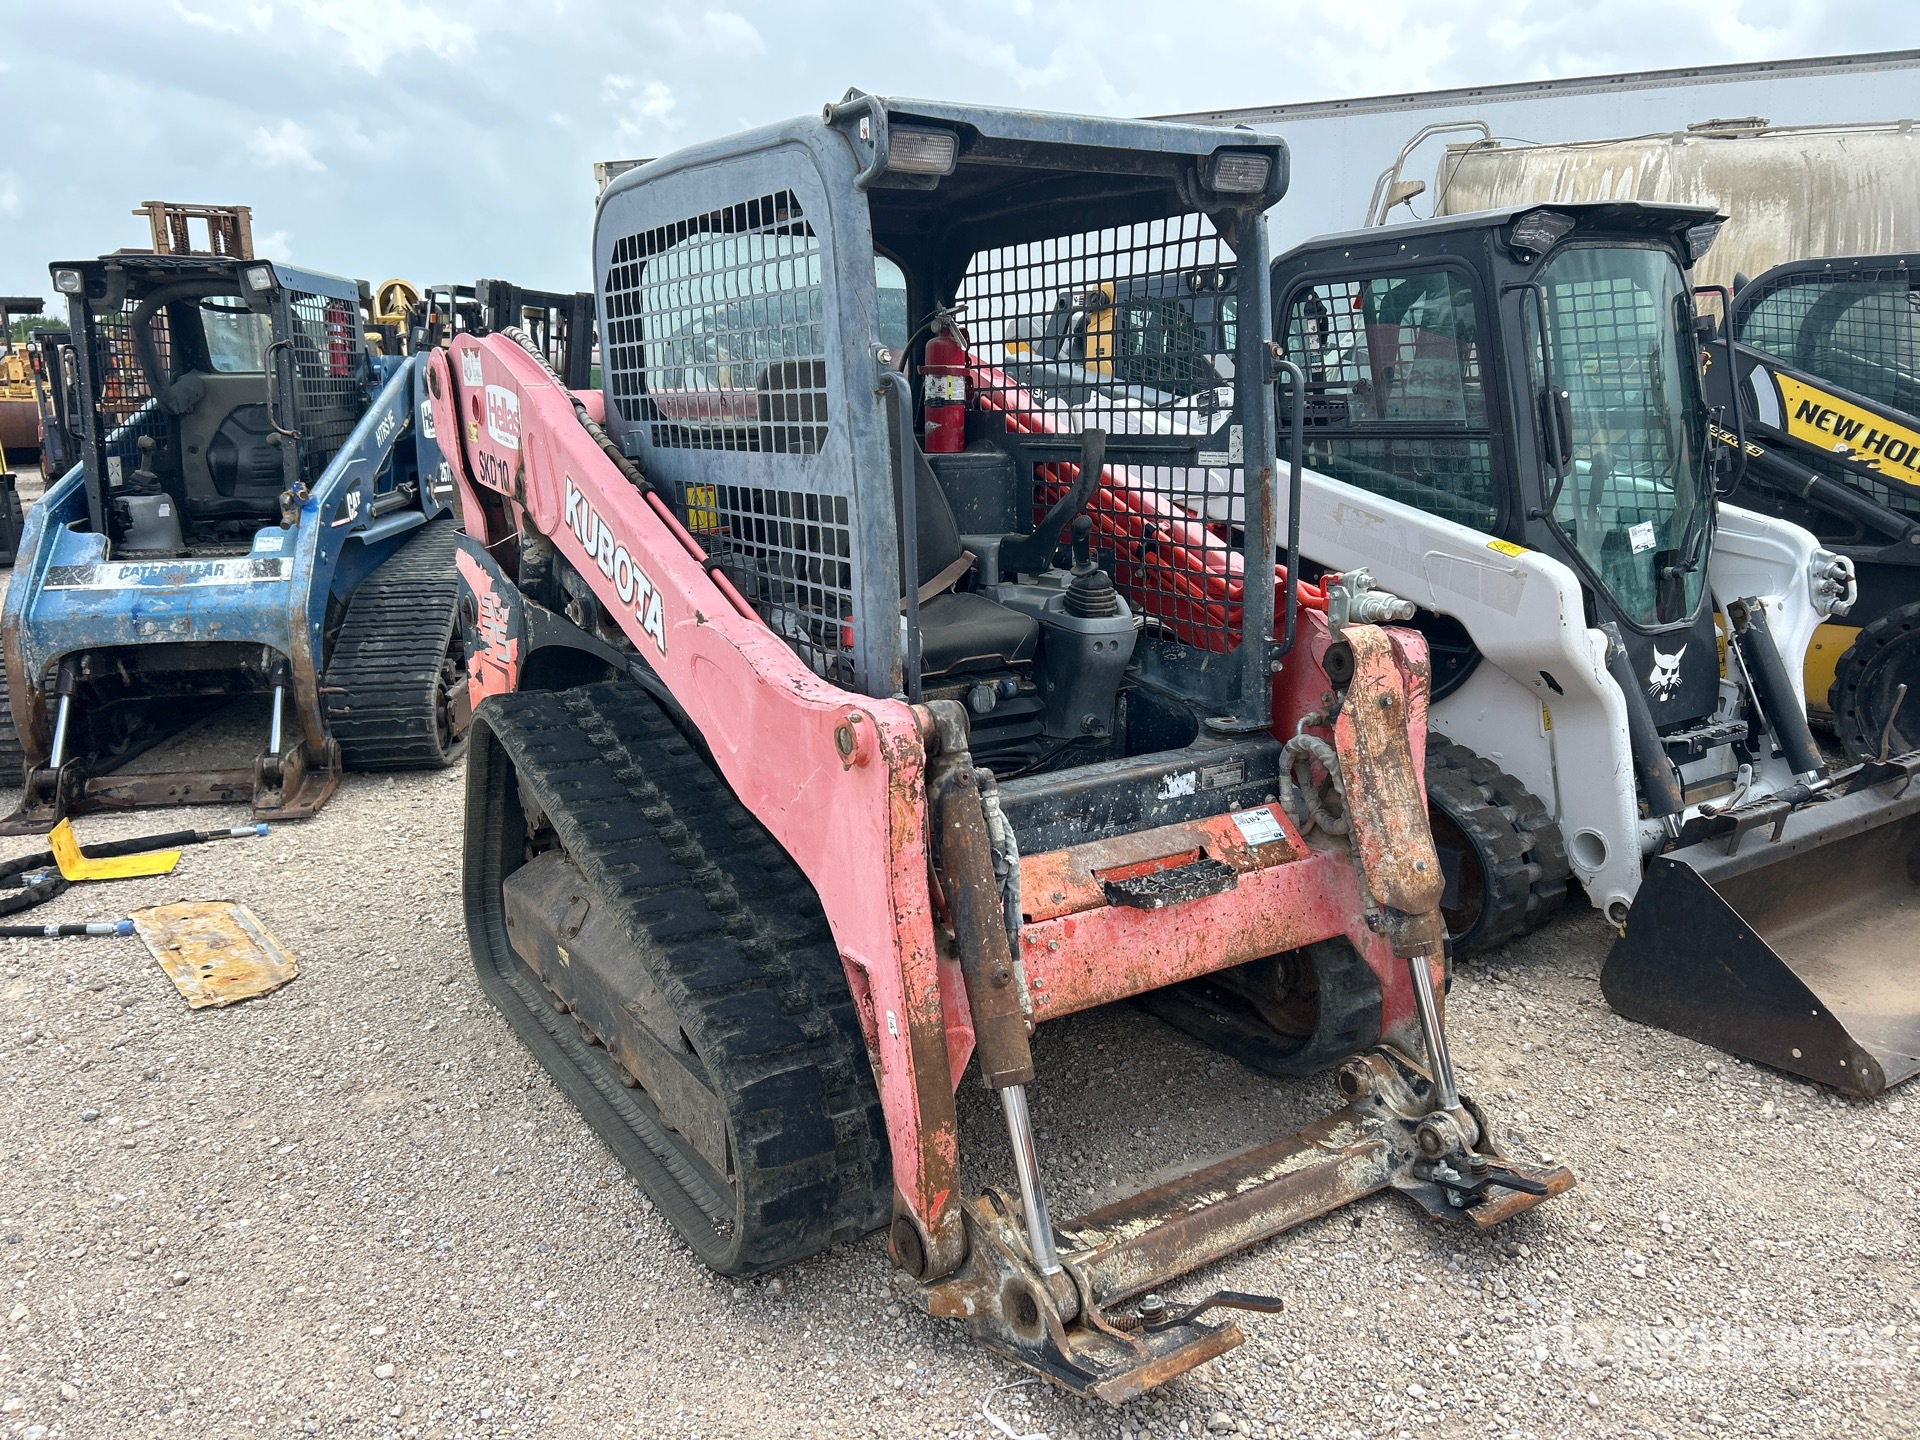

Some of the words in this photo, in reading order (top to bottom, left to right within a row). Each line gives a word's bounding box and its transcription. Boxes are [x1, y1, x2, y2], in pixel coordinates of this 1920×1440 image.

[487, 391, 520, 438] Hellas
[1794, 399, 1864, 443] NEW
[1862, 428, 1920, 473] HOL
[1710, 426, 1763, 455] SERES
[346, 490, 361, 521] CAT
[565, 475, 666, 655] KUBOTA
[482, 620, 511, 664] 75
